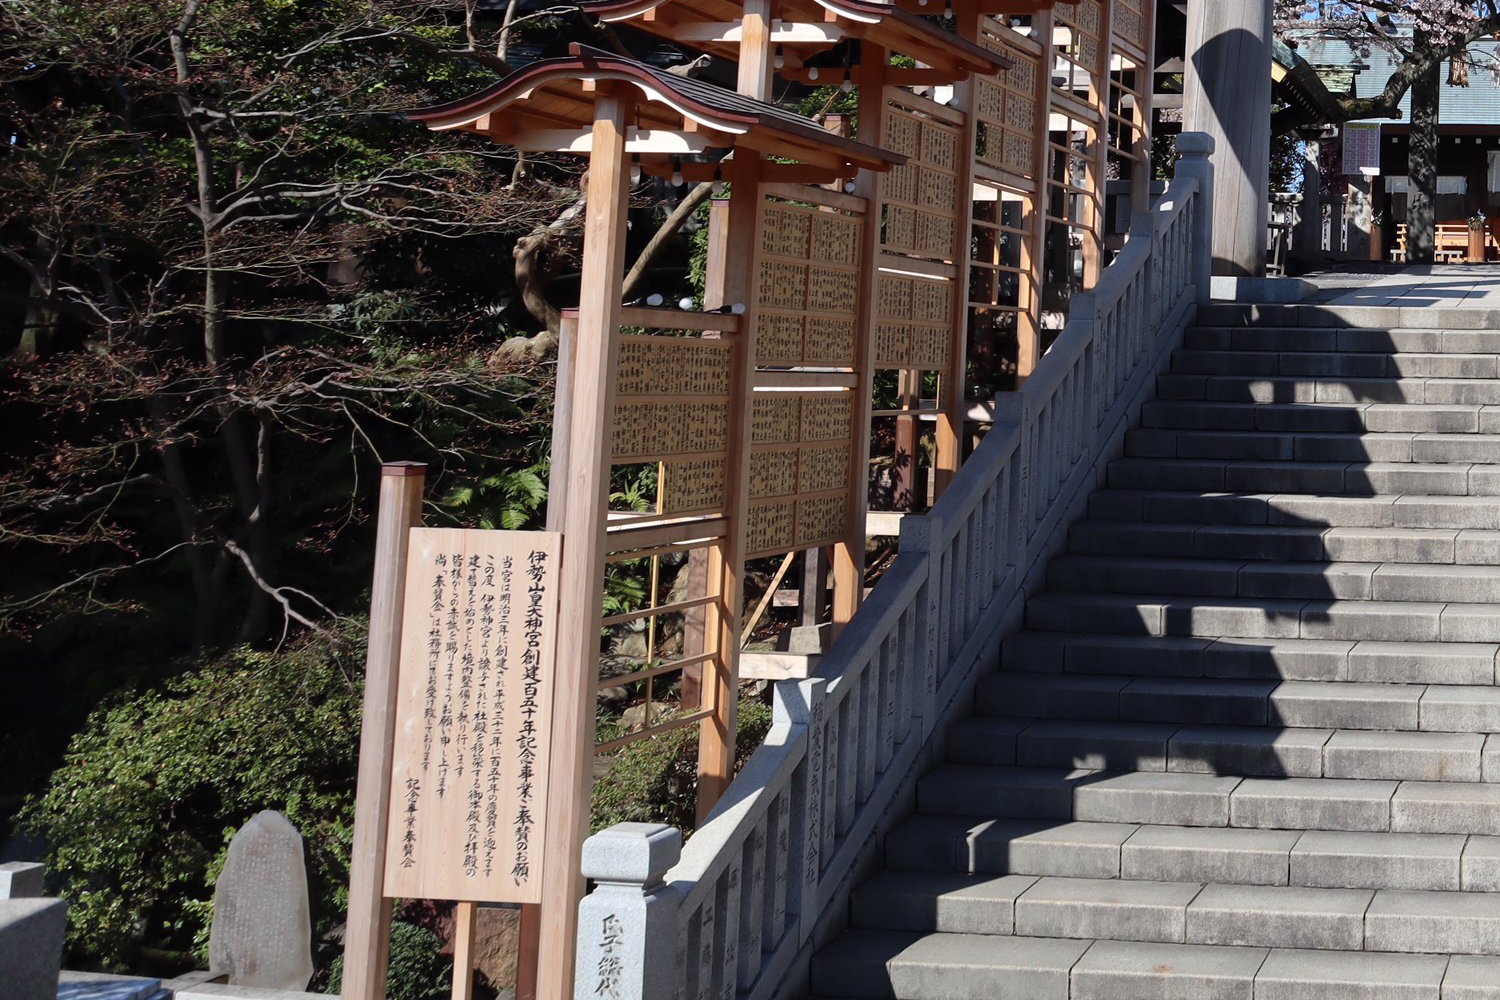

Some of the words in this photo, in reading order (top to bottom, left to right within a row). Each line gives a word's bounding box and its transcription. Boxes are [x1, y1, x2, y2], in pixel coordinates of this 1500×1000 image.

[481, 554, 496, 587] この度
[510, 549, 548, 887] 伊勢山皇大神宮創建百五十年記念事業ご奉賛のお願い
[400, 778, 421, 868] 記念事業奉賛会
